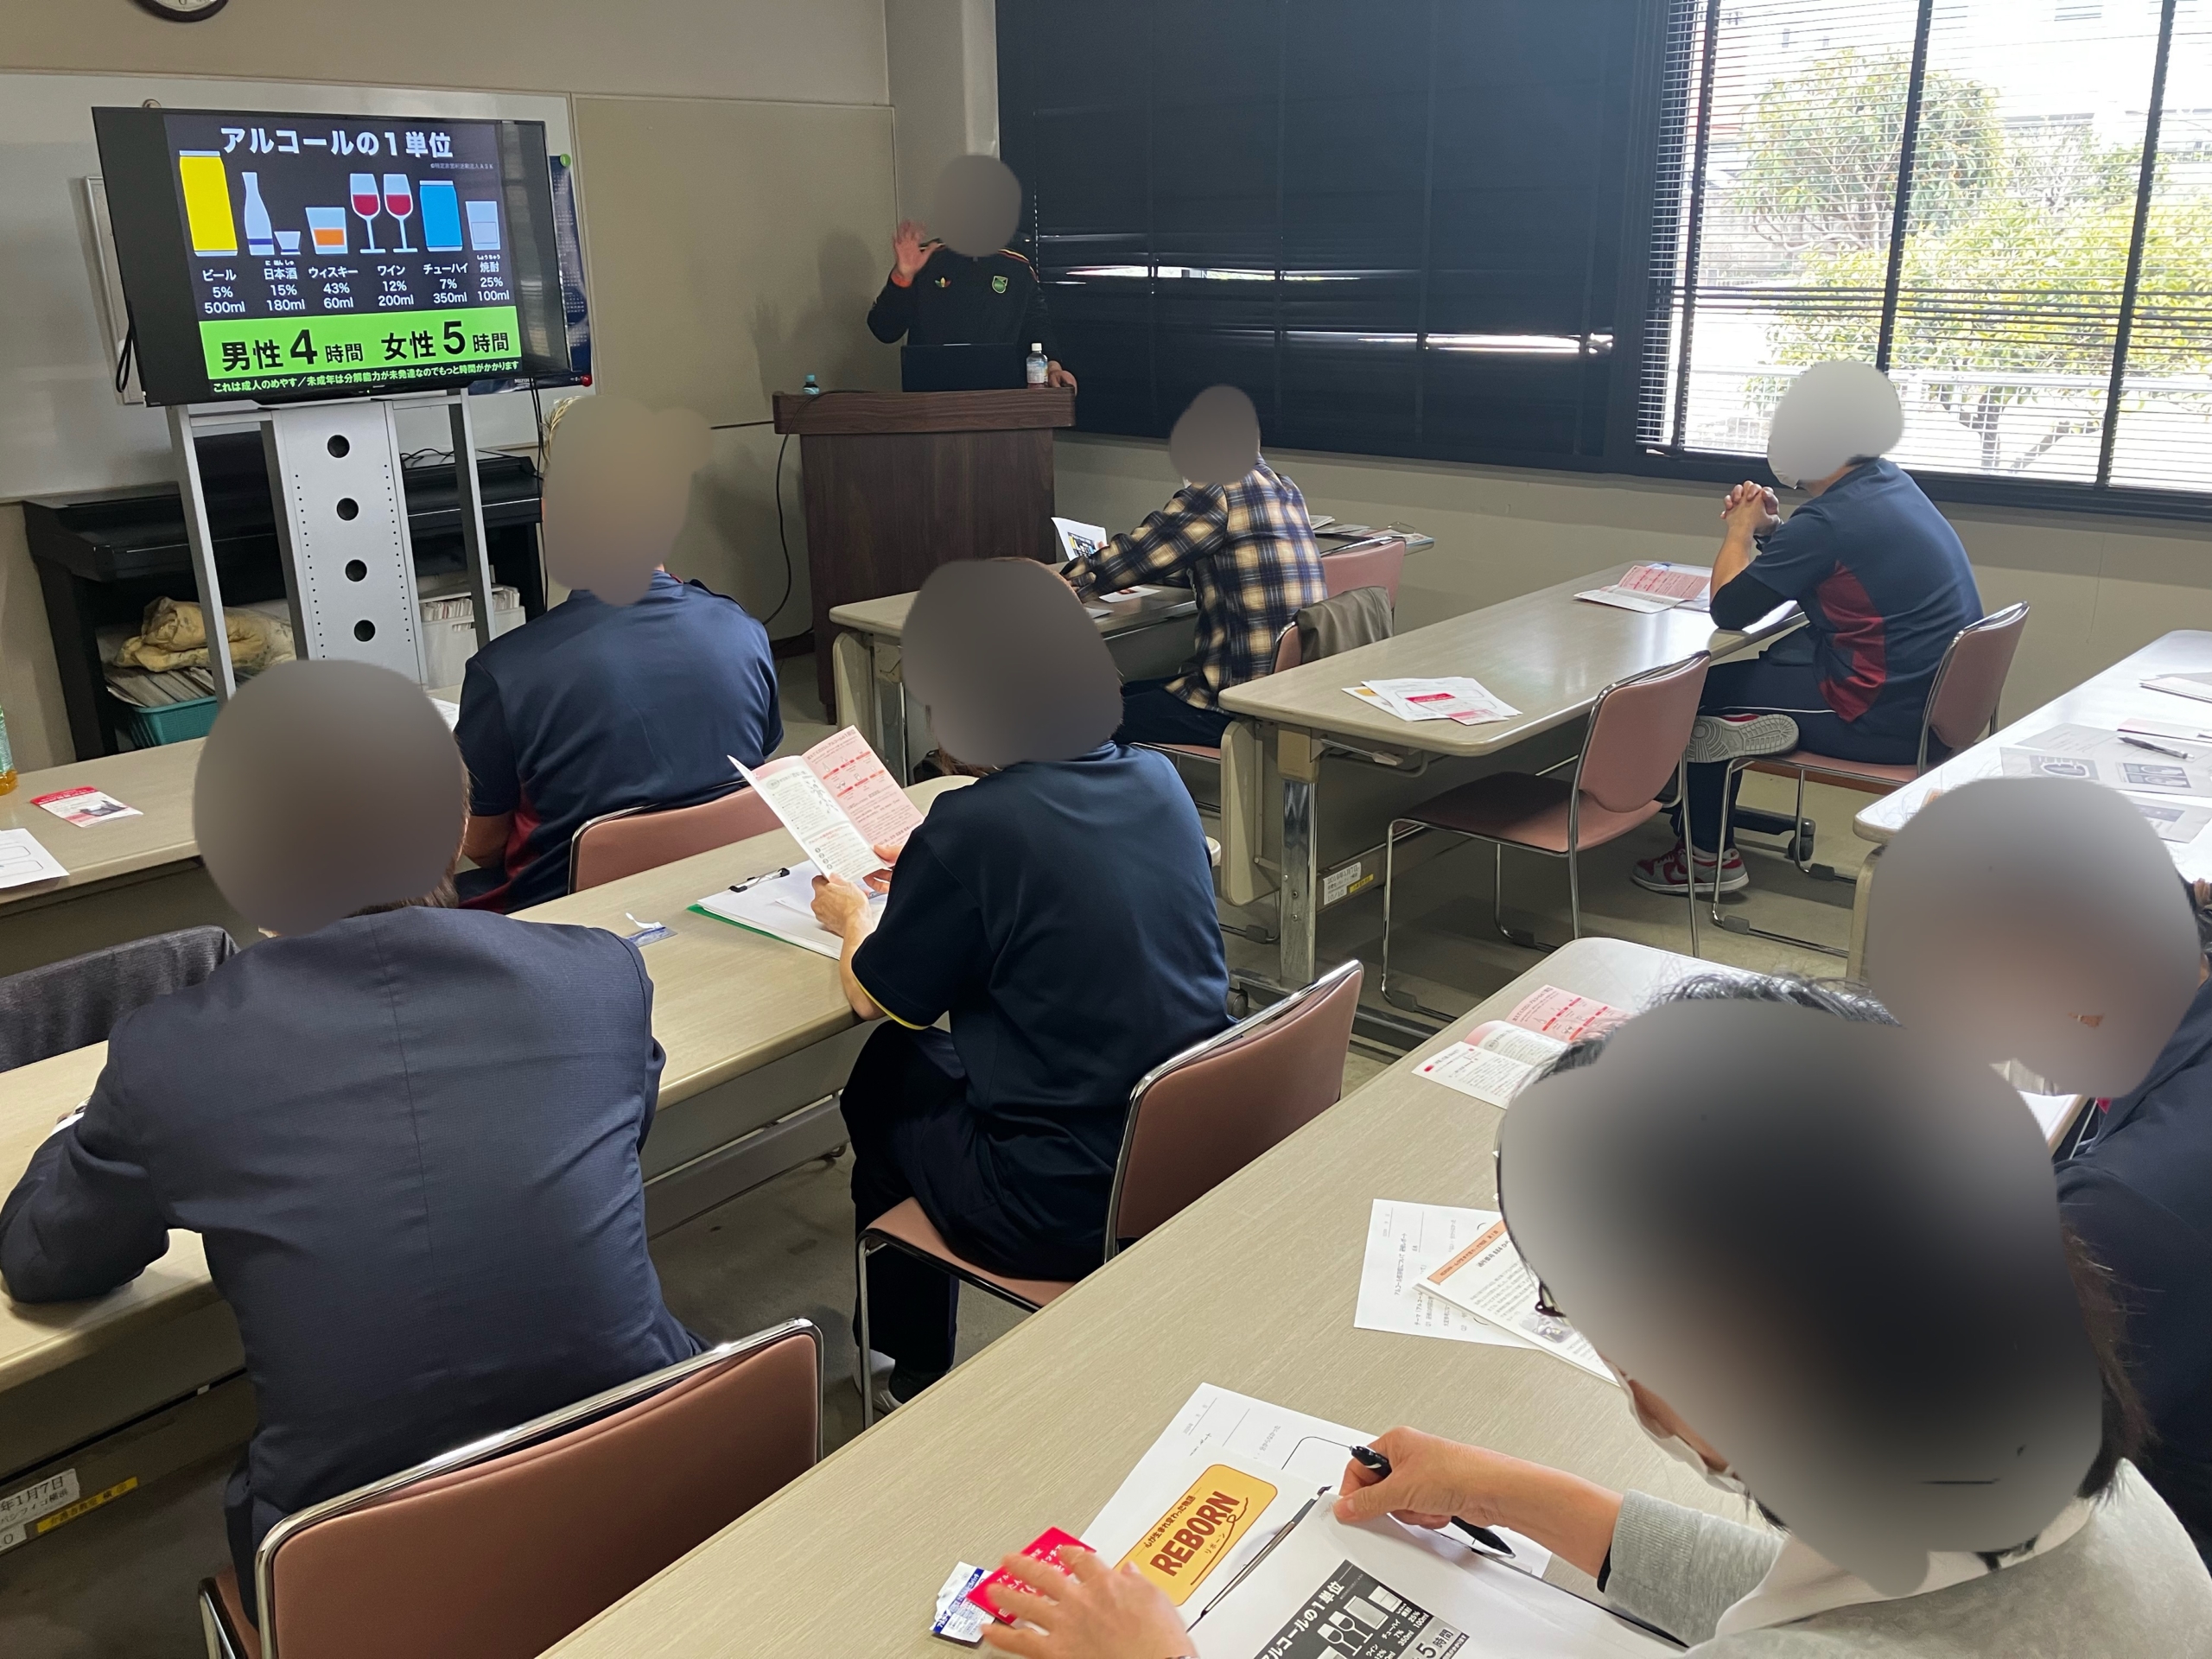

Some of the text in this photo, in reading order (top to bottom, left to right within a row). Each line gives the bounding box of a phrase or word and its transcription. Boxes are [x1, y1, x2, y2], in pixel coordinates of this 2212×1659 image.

[220, 127, 454, 158] アルコールの1単位
[264, 267, 299, 281] 日本酒
[308, 266, 359, 280] ウィスキー
[377, 264, 406, 276] ワイン
[423, 262, 469, 276] チューハイ
[480, 261, 499, 273] 焼酎
[202, 268, 238, 283] ビール
[480, 276, 504, 289] 25%
[270, 283, 298, 297] 15%
[322, 283, 351, 296] 43%
[382, 279, 408, 292] 12%
[439, 277, 458, 289] 7%
[212, 285, 234, 299] 5%
[433, 291, 468, 304] 350ml
[477, 289, 511, 302] 100ml
[203, 300, 247, 315] 500ml
[265, 298, 306, 313] 180ml
[322, 296, 355, 310] 60ml
[378, 294, 415, 308] 200ml
[1149, 1491, 1241, 1577] REBORN
[1413, 1612, 1430, 1629] 100ml
[1382, 1618, 1402, 1640] チューハイ
[1397, 1630, 1414, 1647] 350ml
[1365, 1643, 1379, 1656] ワイン
